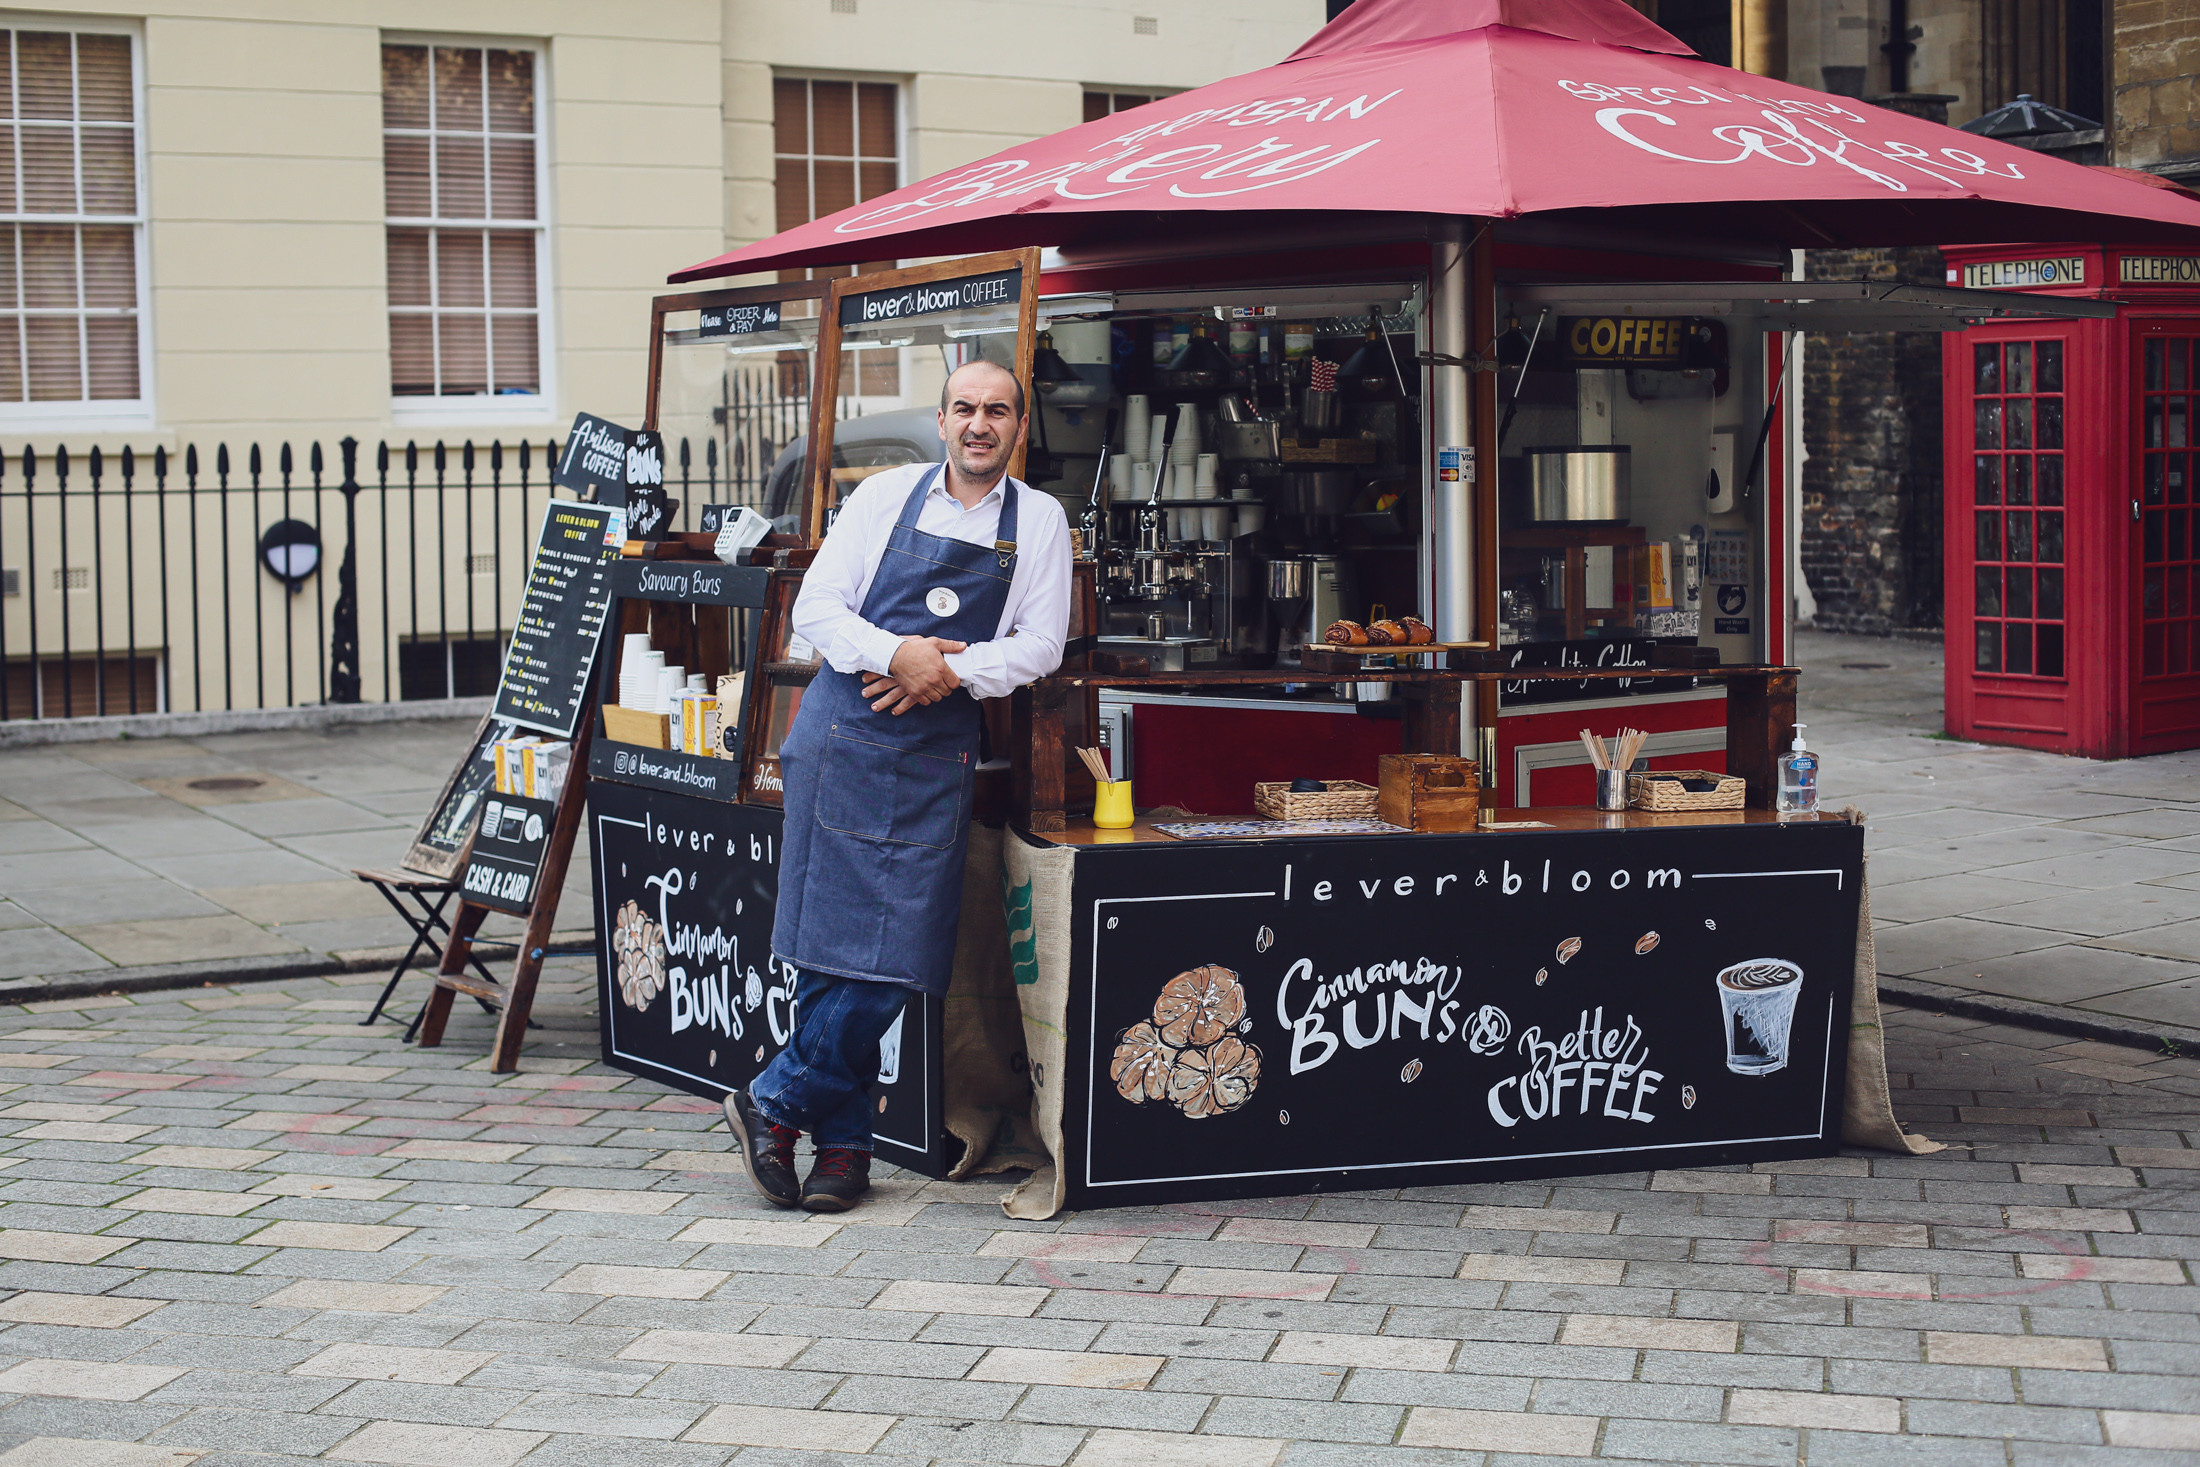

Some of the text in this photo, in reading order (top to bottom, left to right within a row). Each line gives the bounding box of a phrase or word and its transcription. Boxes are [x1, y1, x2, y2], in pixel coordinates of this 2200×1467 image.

[1966, 258, 2083, 287] TELEPHONE
[2121, 257, 2200, 280] TELEPHON
[963, 278, 1008, 304] COFFEE
[701, 314, 722, 328] Please
[726, 306, 761, 322] ORDER
[736, 319, 755, 333] PAY
[1571, 318, 1682, 355] COFFEE
[581, 450, 622, 481] COFFEE
[1461, 453, 1475, 461] VISA
[563, 529, 587, 541] COFFEE
[638, 566, 722, 598] Savoury Buns
[524, 600, 543, 612] LATTE
[536, 617, 556, 630] BLCK
[646, 812, 714, 853] lever
[464, 863, 530, 902] CASH & CARD
[644, 867, 743, 978] Cinnamon
[1276, 956, 1462, 1031] Cinnamon
[1518, 1006, 1649, 1085] Better
[1487, 1061, 1665, 1128] COFFEE
